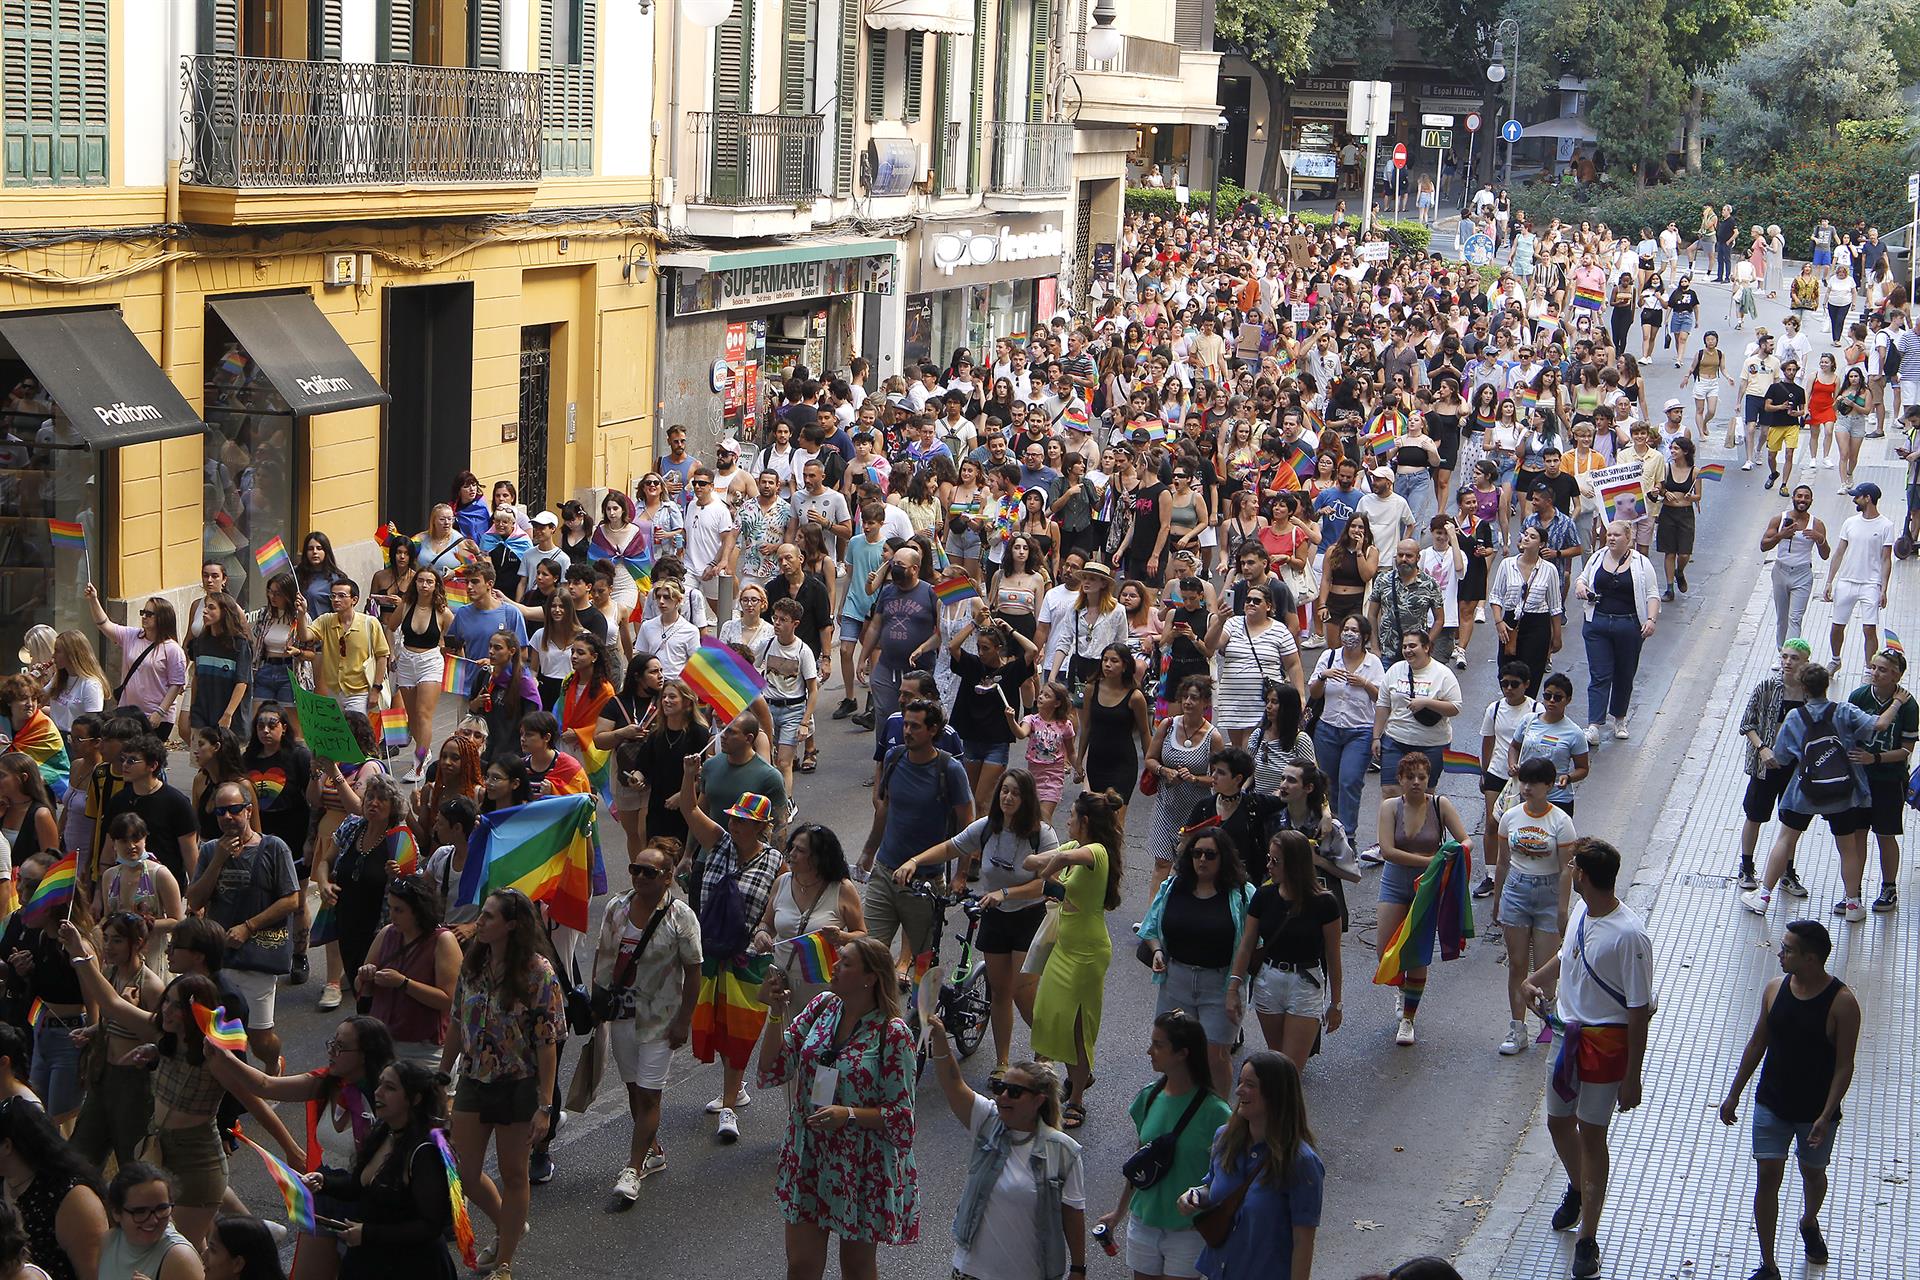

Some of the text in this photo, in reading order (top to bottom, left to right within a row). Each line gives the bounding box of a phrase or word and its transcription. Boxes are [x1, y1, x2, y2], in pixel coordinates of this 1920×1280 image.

[1305, 79, 1337, 91] Espai
[724, 261, 822, 297] SUPERMARKET
[293, 374, 353, 396] Poliform
[93, 402, 163, 426] Poliform
[1396, 679, 1431, 696] MAVEL
[1815, 747, 1838, 767] adidas
